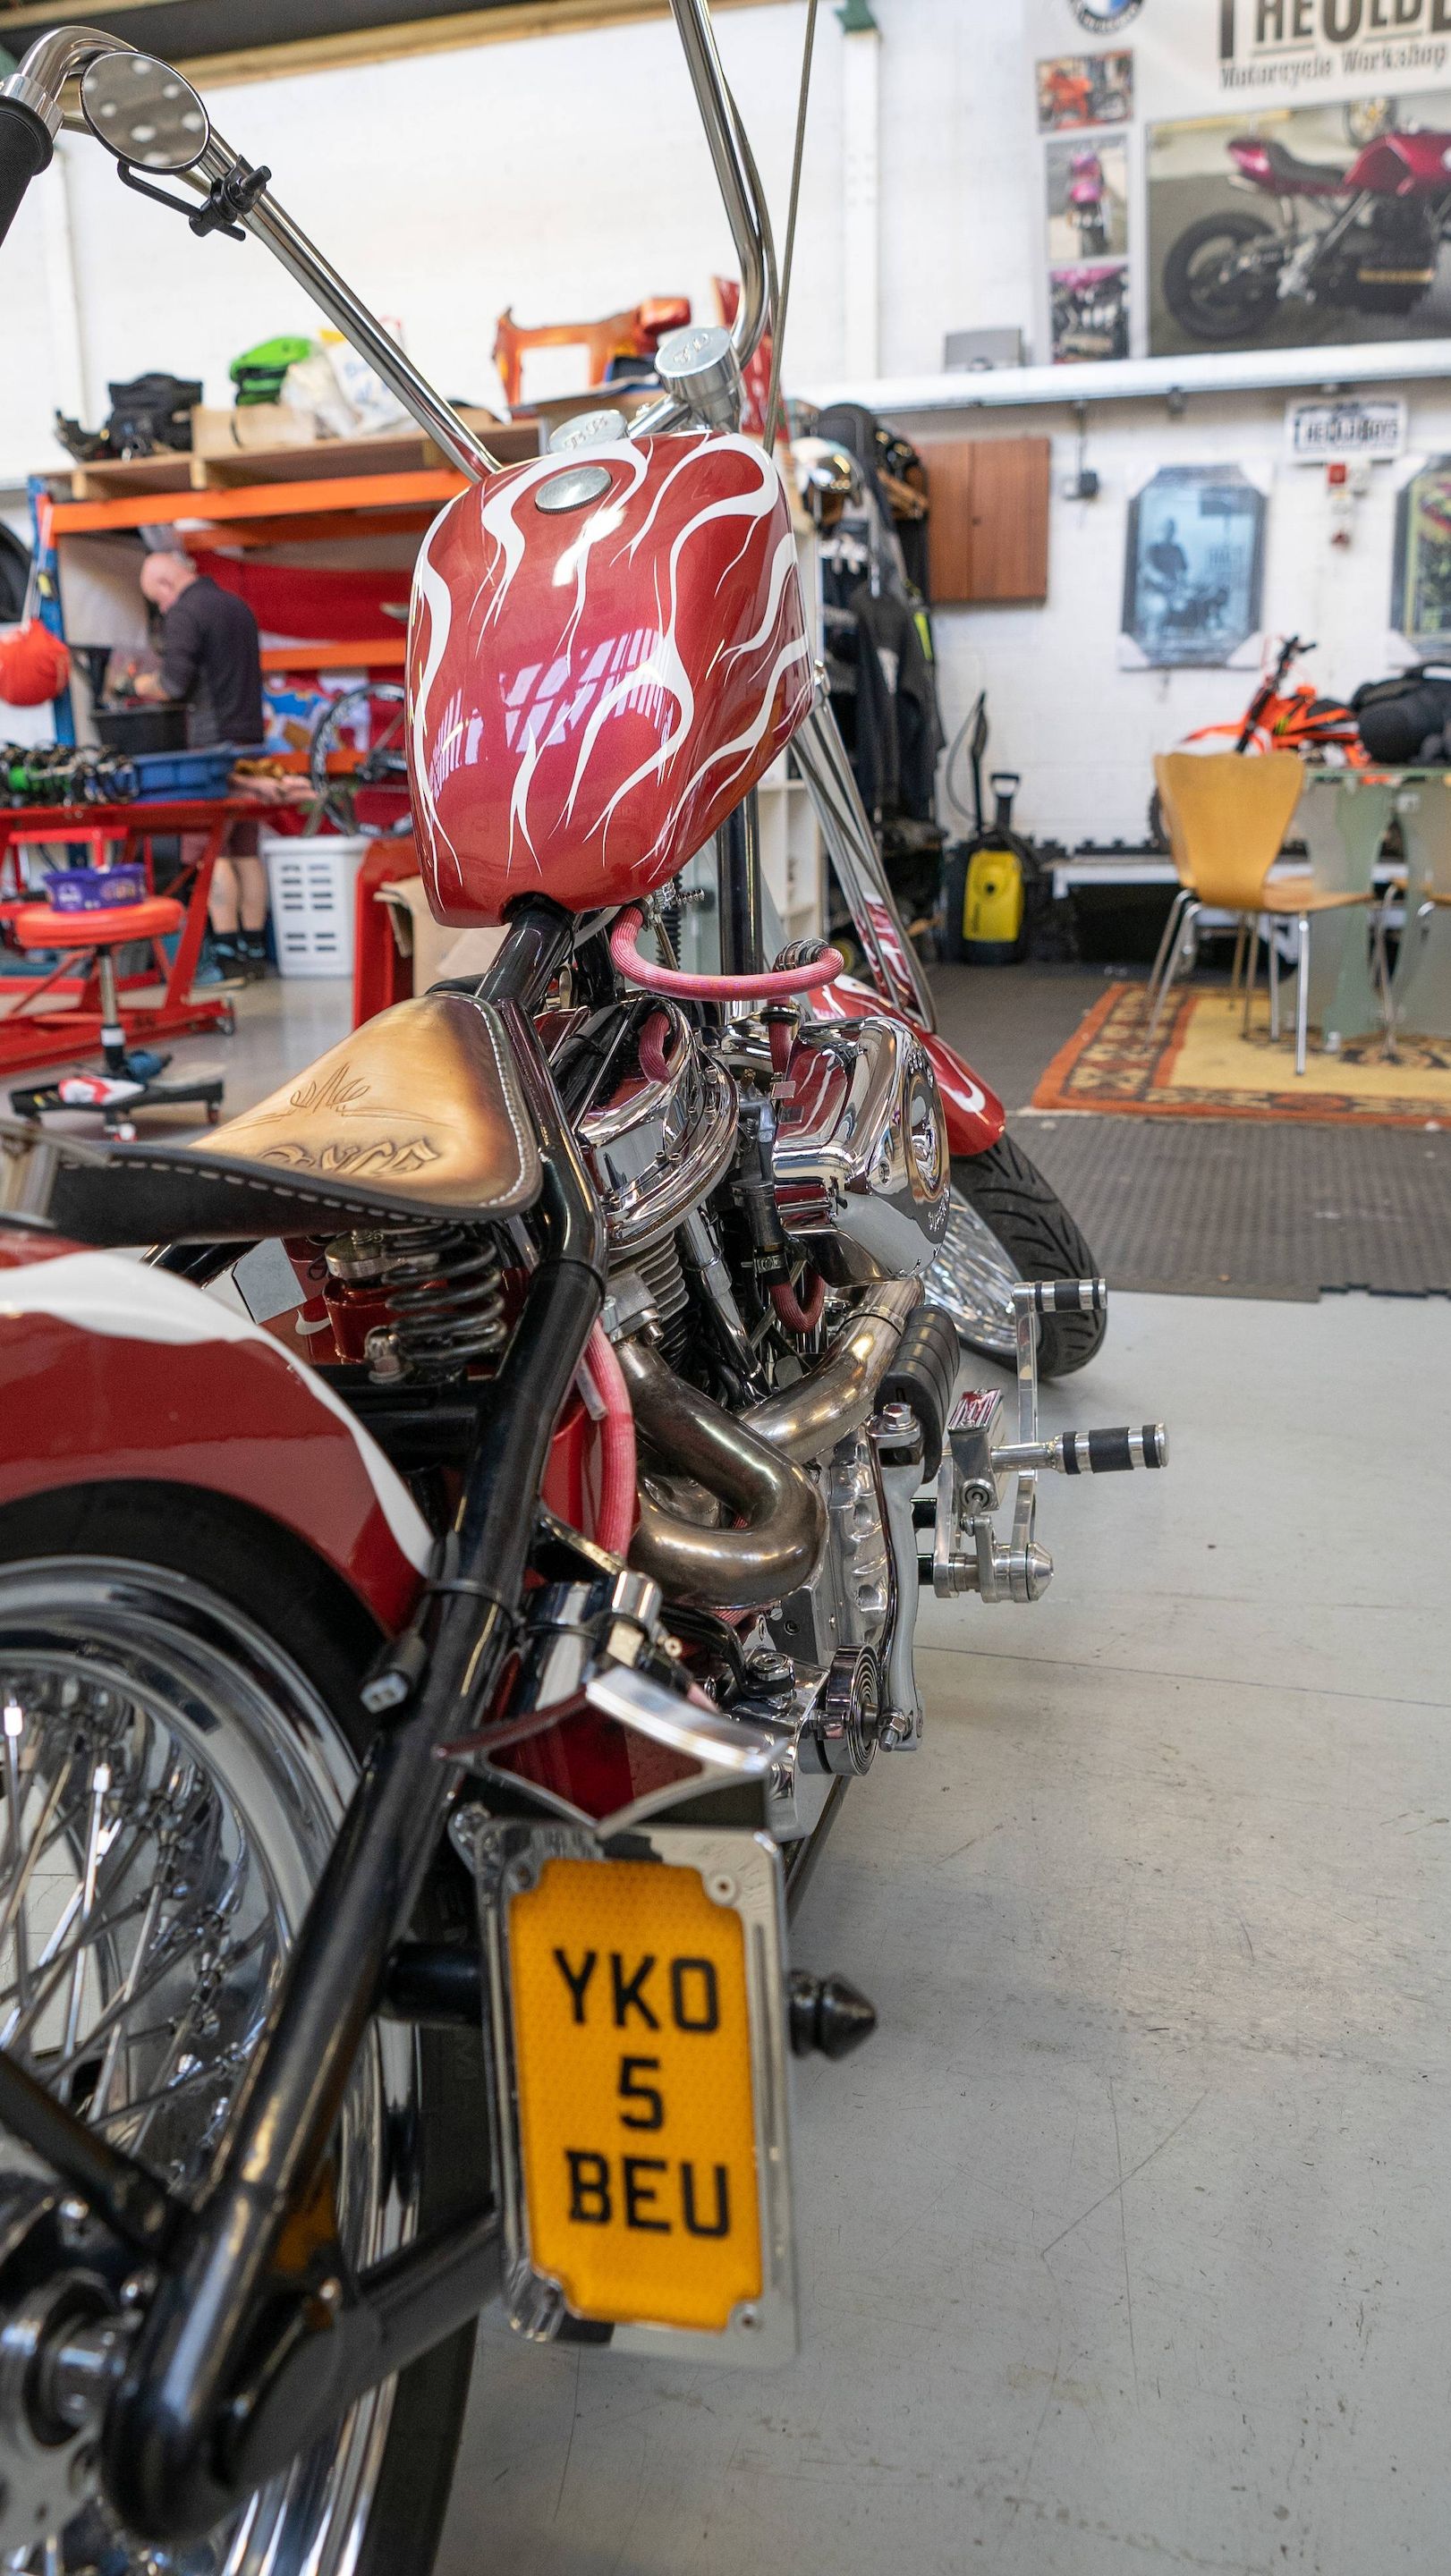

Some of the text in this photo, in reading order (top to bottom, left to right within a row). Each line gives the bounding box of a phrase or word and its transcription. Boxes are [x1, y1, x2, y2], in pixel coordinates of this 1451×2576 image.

[1222, 45, 1447, 88] Motorcycle Workshop
[618, 2055, 664, 2131] 5
[564, 2149, 731, 2239] BEU
